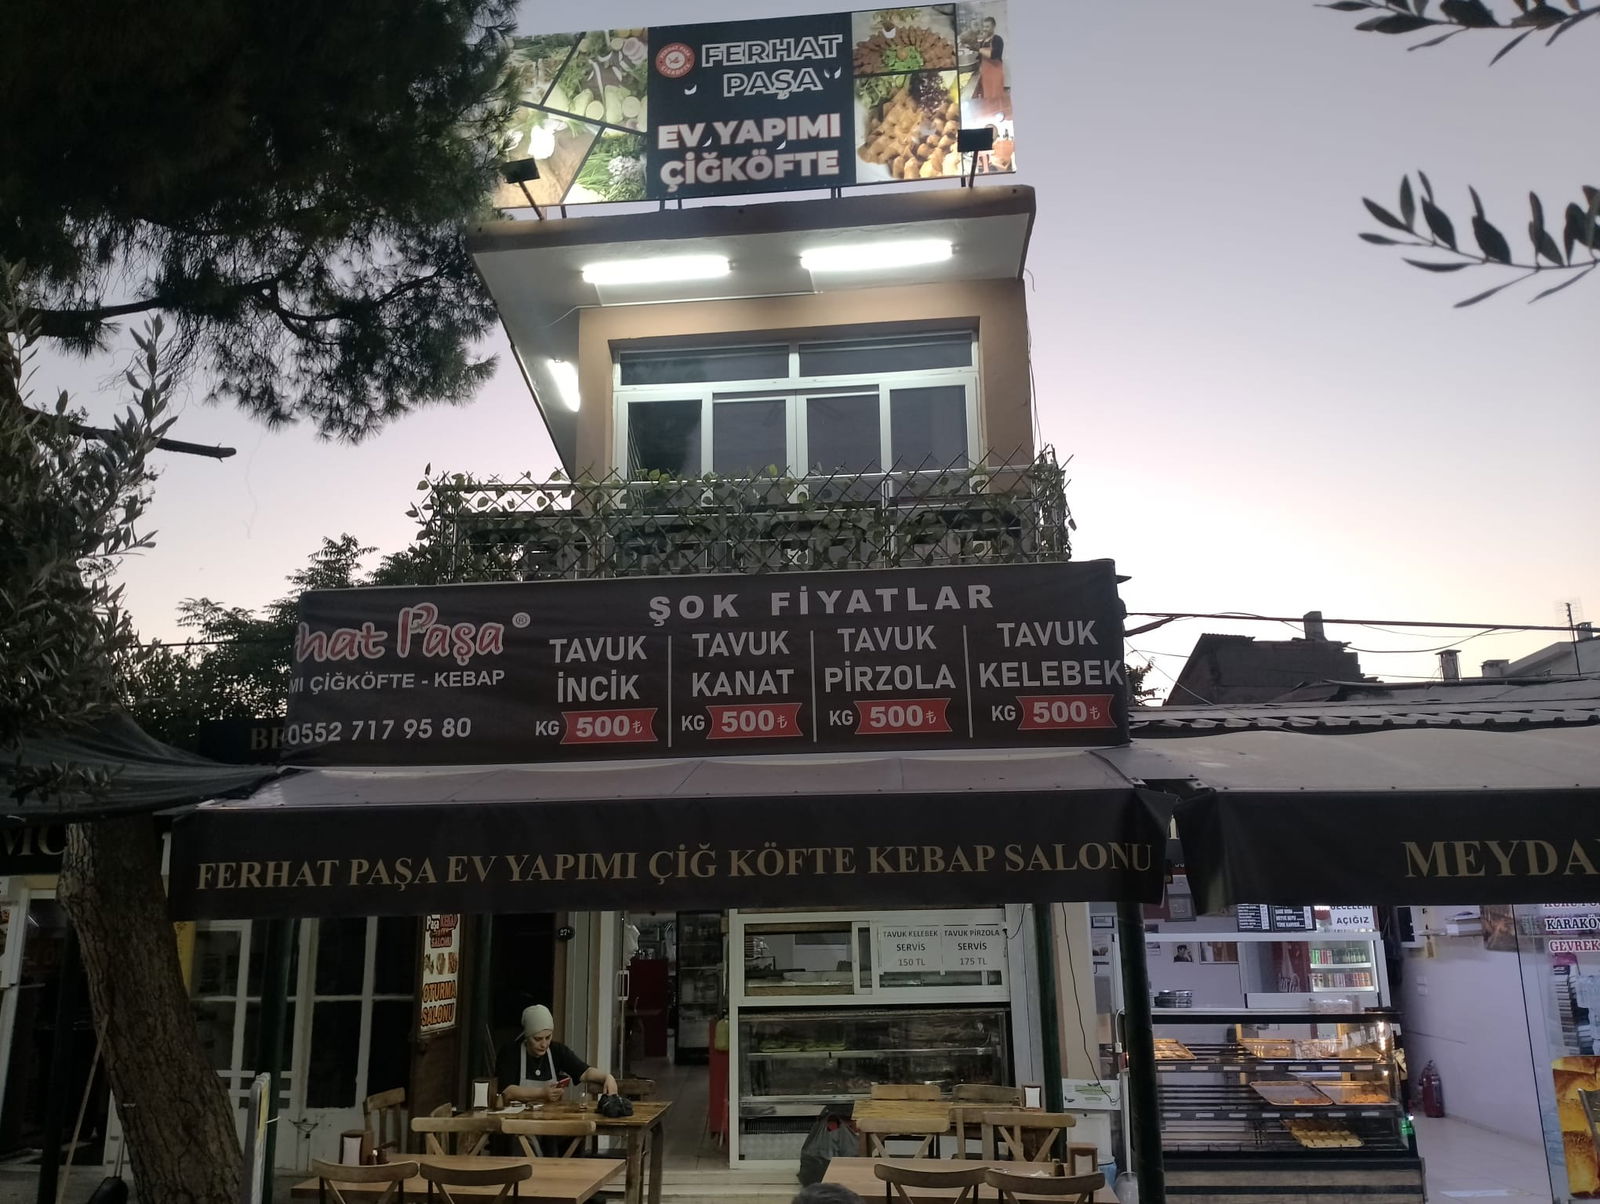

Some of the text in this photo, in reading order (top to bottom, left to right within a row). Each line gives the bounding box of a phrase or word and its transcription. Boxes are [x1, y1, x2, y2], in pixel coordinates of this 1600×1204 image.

[701, 34, 843, 67] FERHAT
[723, 67, 824, 99] PAŞA
[657, 112, 841, 149] EV YAPIMI
[659, 149, 840, 192] ÇİĞKÖFTE
[648, 584, 994, 626] ŞOK FİYATLAR
[294, 621, 387, 663] hat
[396, 602, 505, 666] Paşa
[692, 630, 791, 658] TAVUK
[837, 625, 937, 653] TAVUK
[996, 620, 1099, 648] TAVUK
[549, 635, 648, 664] TAVUK
[310, 670, 415, 695] ÇİĞKÖFTE
[434, 670, 506, 689] KEBAP
[557, 669, 641, 703] İNCİK
[691, 668, 795, 698] KANAT
[824, 661, 956, 693] PİRZOLA
[978, 659, 1124, 689] KELEBEK
[681, 715, 705, 732] KG
[829, 710, 853, 727] KG
[991, 705, 1016, 722] KG
[286, 717, 472, 746] 0552 717 95 80
[535, 720, 560, 737] KG
[195, 842, 1153, 892] FERHAT PAŞA EV YAPIMI ÇİĞ KÖFTE KEBAP SALONU
[908, 930, 938, 938] KELEBEK
[970, 929, 1000, 937] PİRZOLA
[1336, 915, 1370, 925] AÇIĞIZ
[896, 943, 926, 951] SERVİS
[957, 942, 987, 951] SERVİS
[899, 958, 926, 966] 150 TL
[978, 957, 987, 965] TL
[423, 980, 457, 1003] OTURMA
[421, 1003, 455, 1027] SALONU
